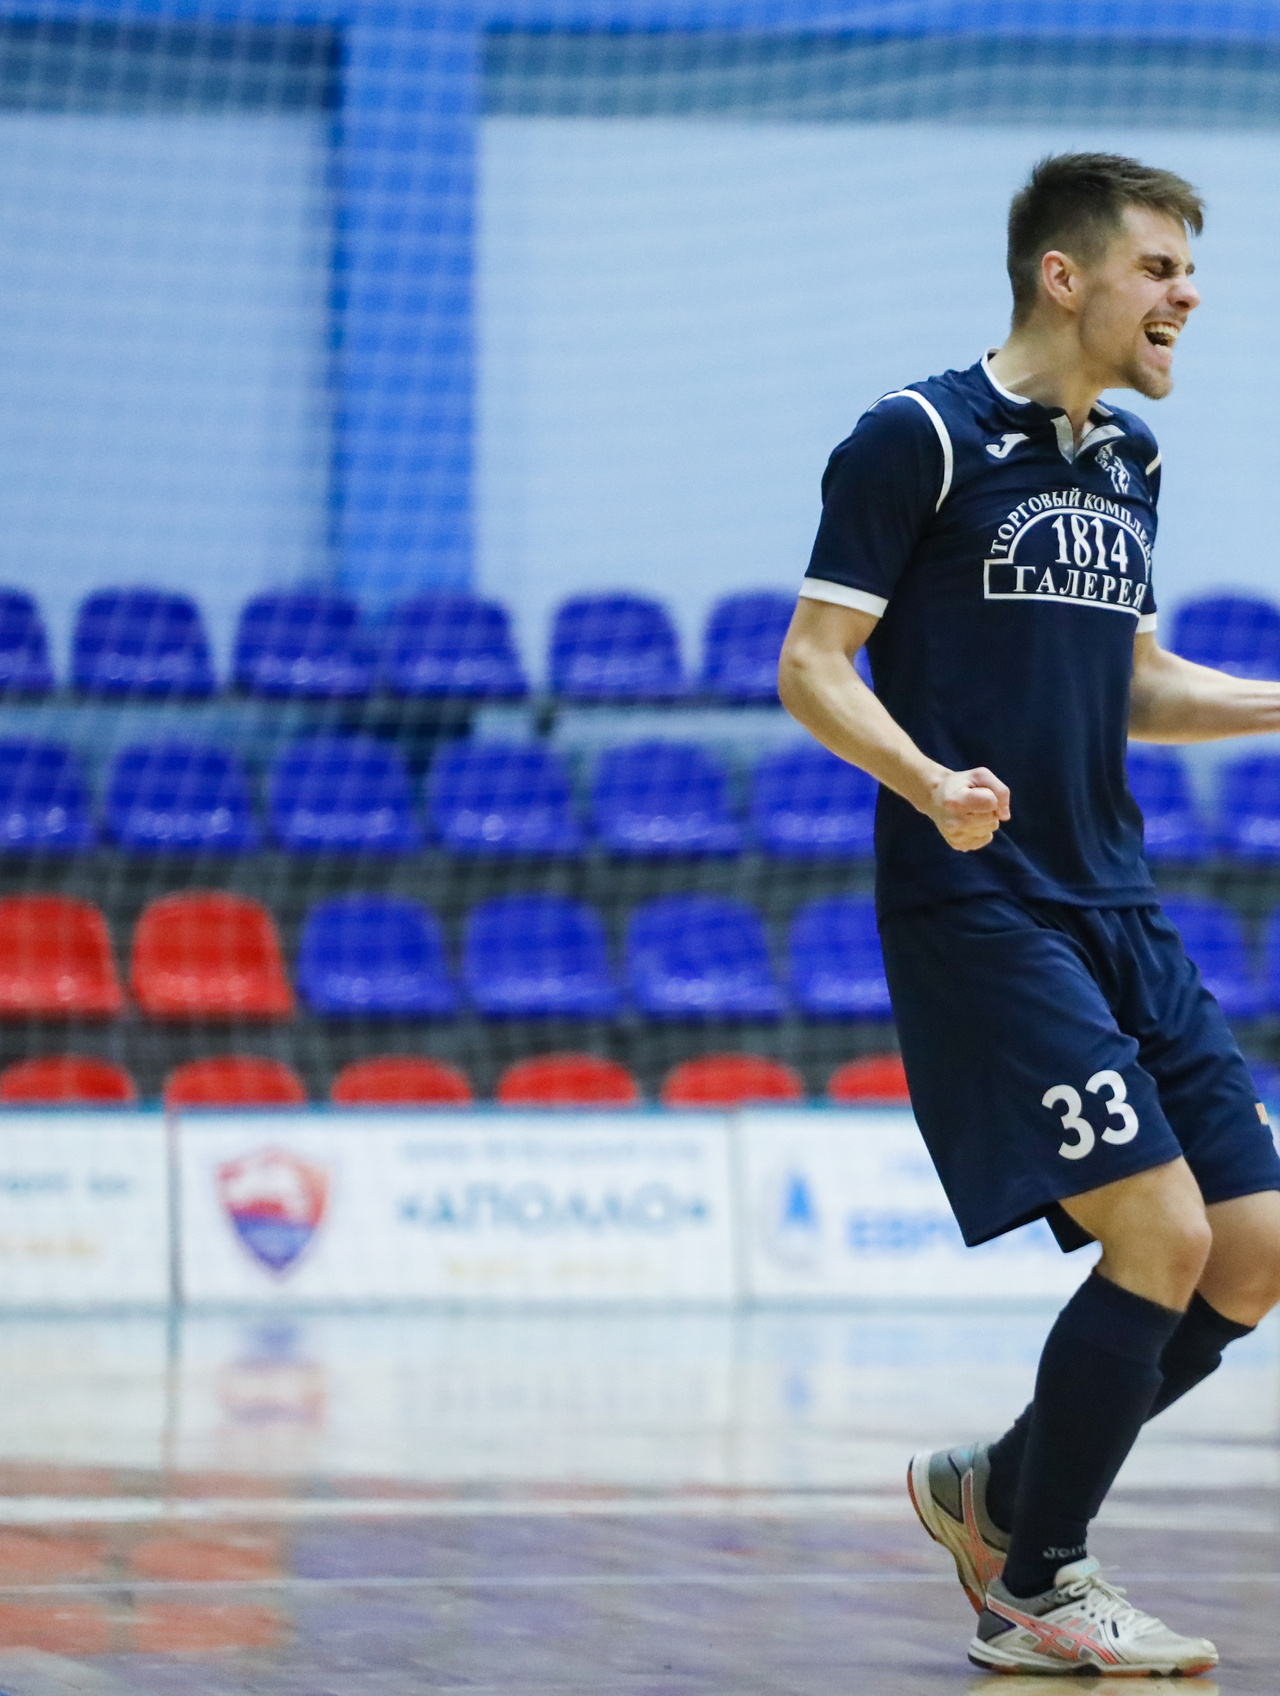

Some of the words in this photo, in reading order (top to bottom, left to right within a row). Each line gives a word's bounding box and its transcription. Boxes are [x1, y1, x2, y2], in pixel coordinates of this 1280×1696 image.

[990, 487, 1082, 555] ТОРГОВЫЙ
[1052, 514, 1128, 573] 1814
[1013, 566, 1147, 610] ГАЛЕРЕЯ
[1041, 1070, 1139, 1160] 33
